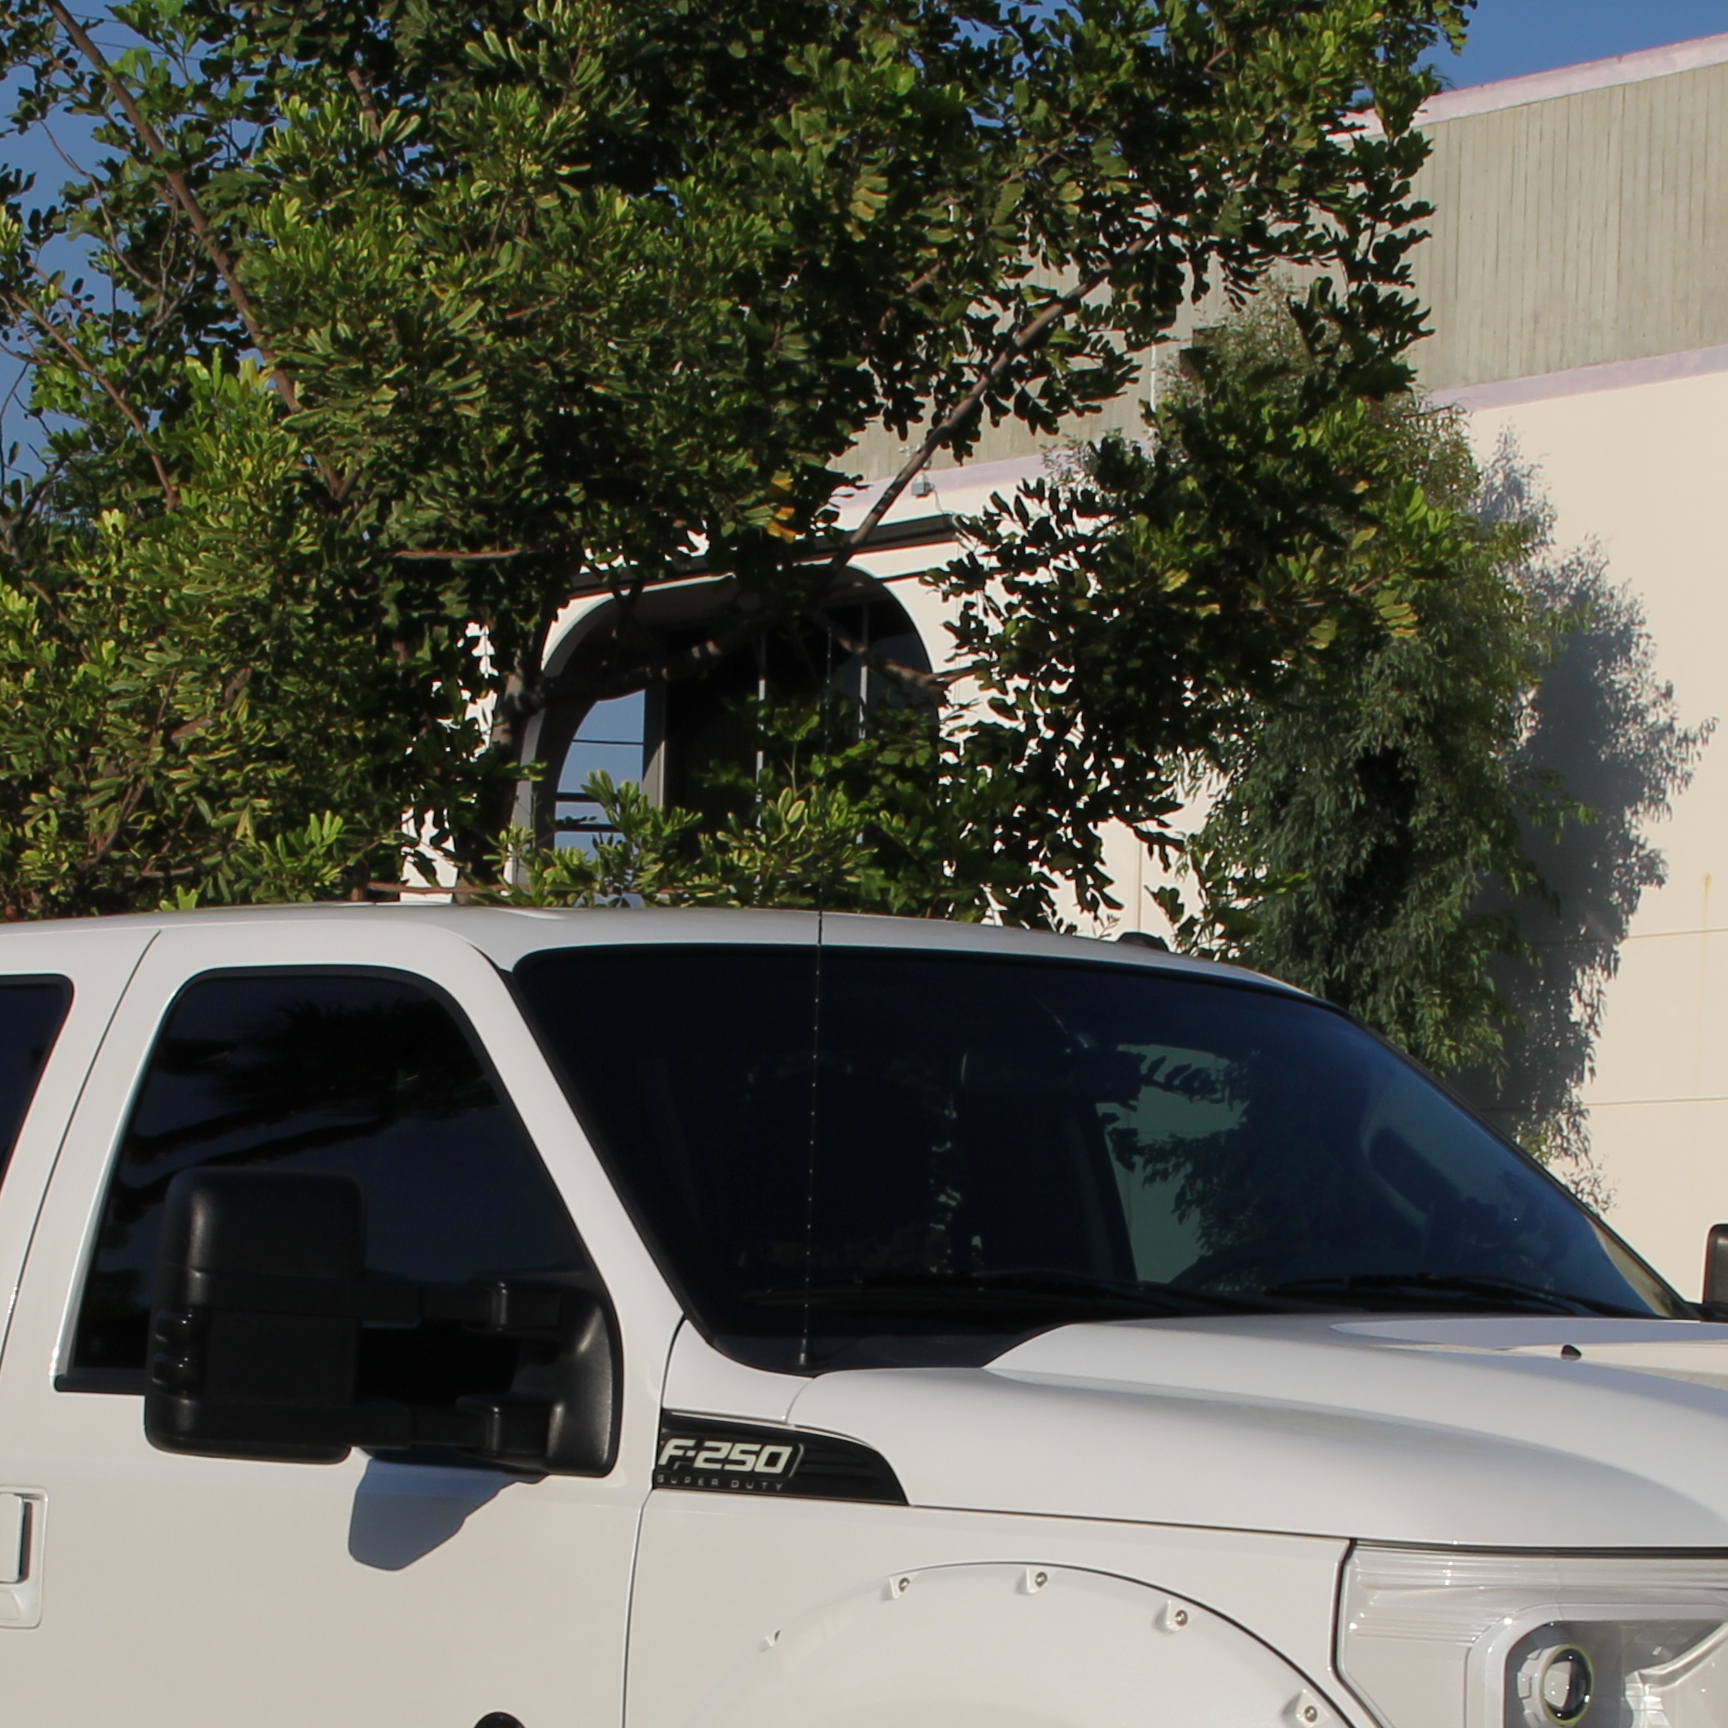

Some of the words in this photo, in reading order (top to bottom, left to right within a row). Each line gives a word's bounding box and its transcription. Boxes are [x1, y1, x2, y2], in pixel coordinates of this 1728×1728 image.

[657, 1438, 794, 1475] F-250
[656, 1474, 720, 1487] SUPER
[730, 1479, 784, 1491] DUTY
